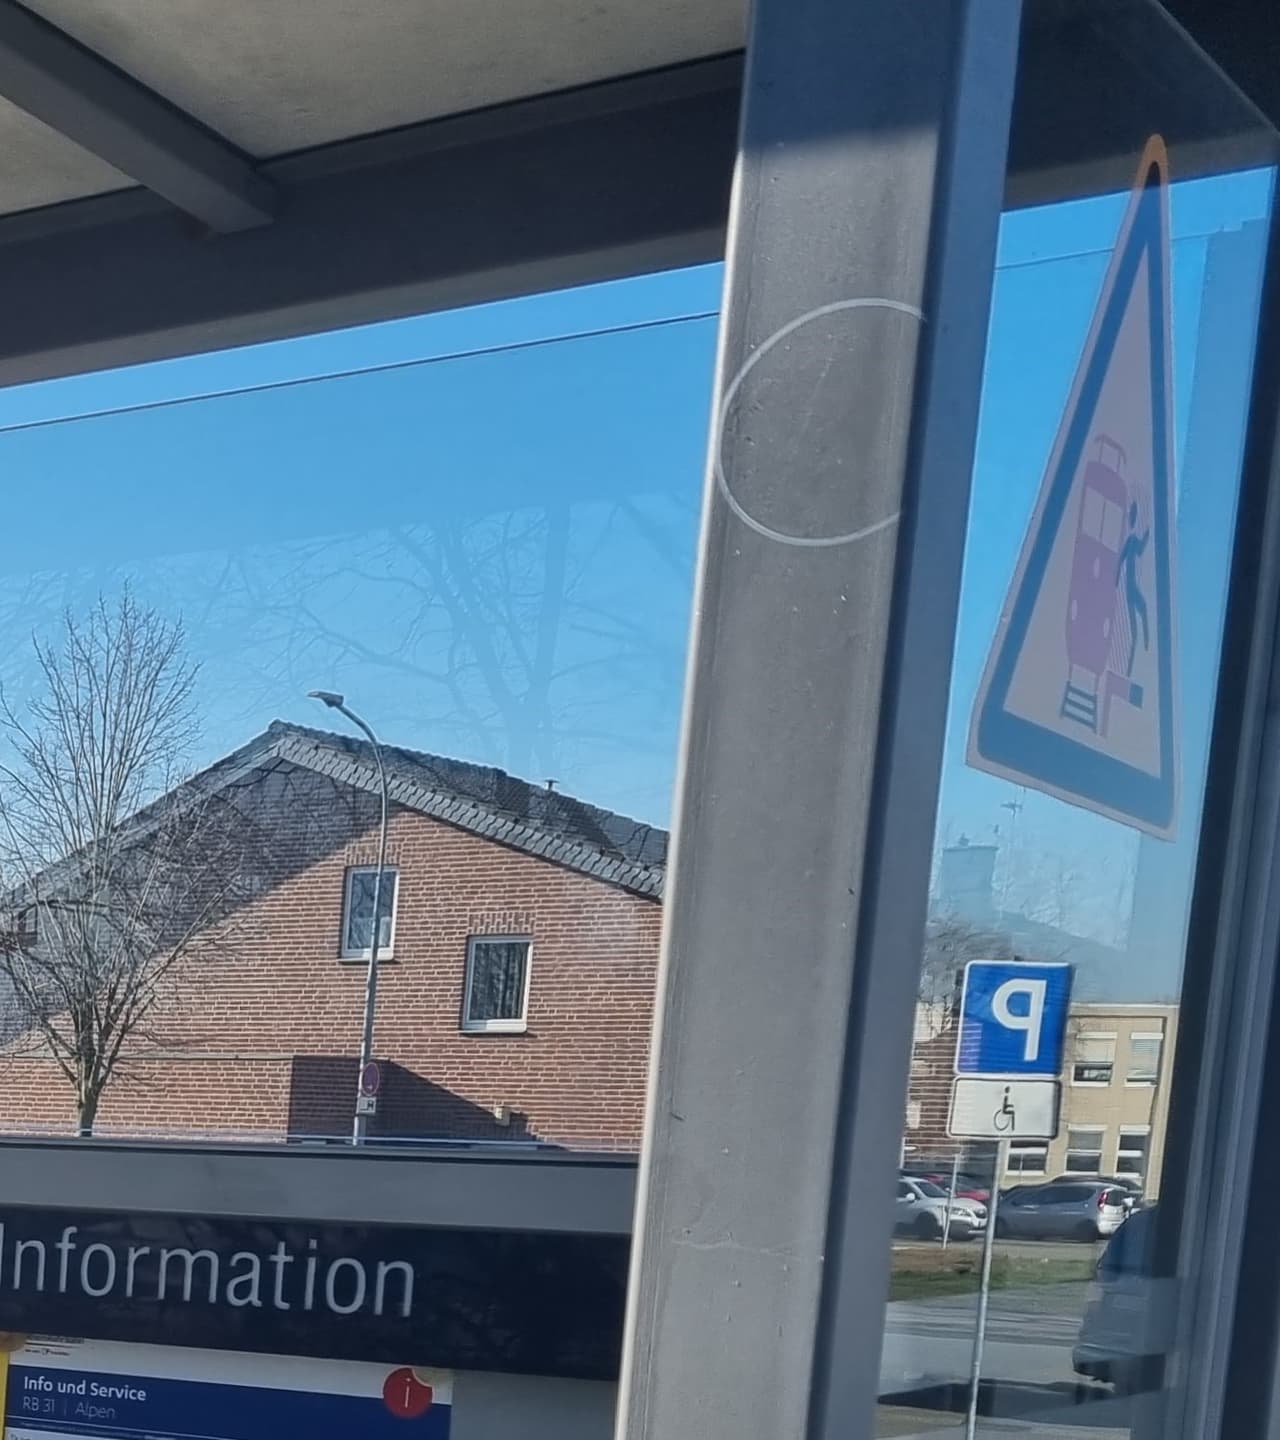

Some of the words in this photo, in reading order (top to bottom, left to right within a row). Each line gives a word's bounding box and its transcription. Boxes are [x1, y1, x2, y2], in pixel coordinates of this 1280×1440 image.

[24, 1376, 53, 1391] Info
[57, 1379, 86, 1395] und
[90, 1382, 147, 1401] Service
[23, 1396, 40, 1411] RB
[42, 1398, 55, 1413] 31
[75, 1401, 116, 1420] Alpen
